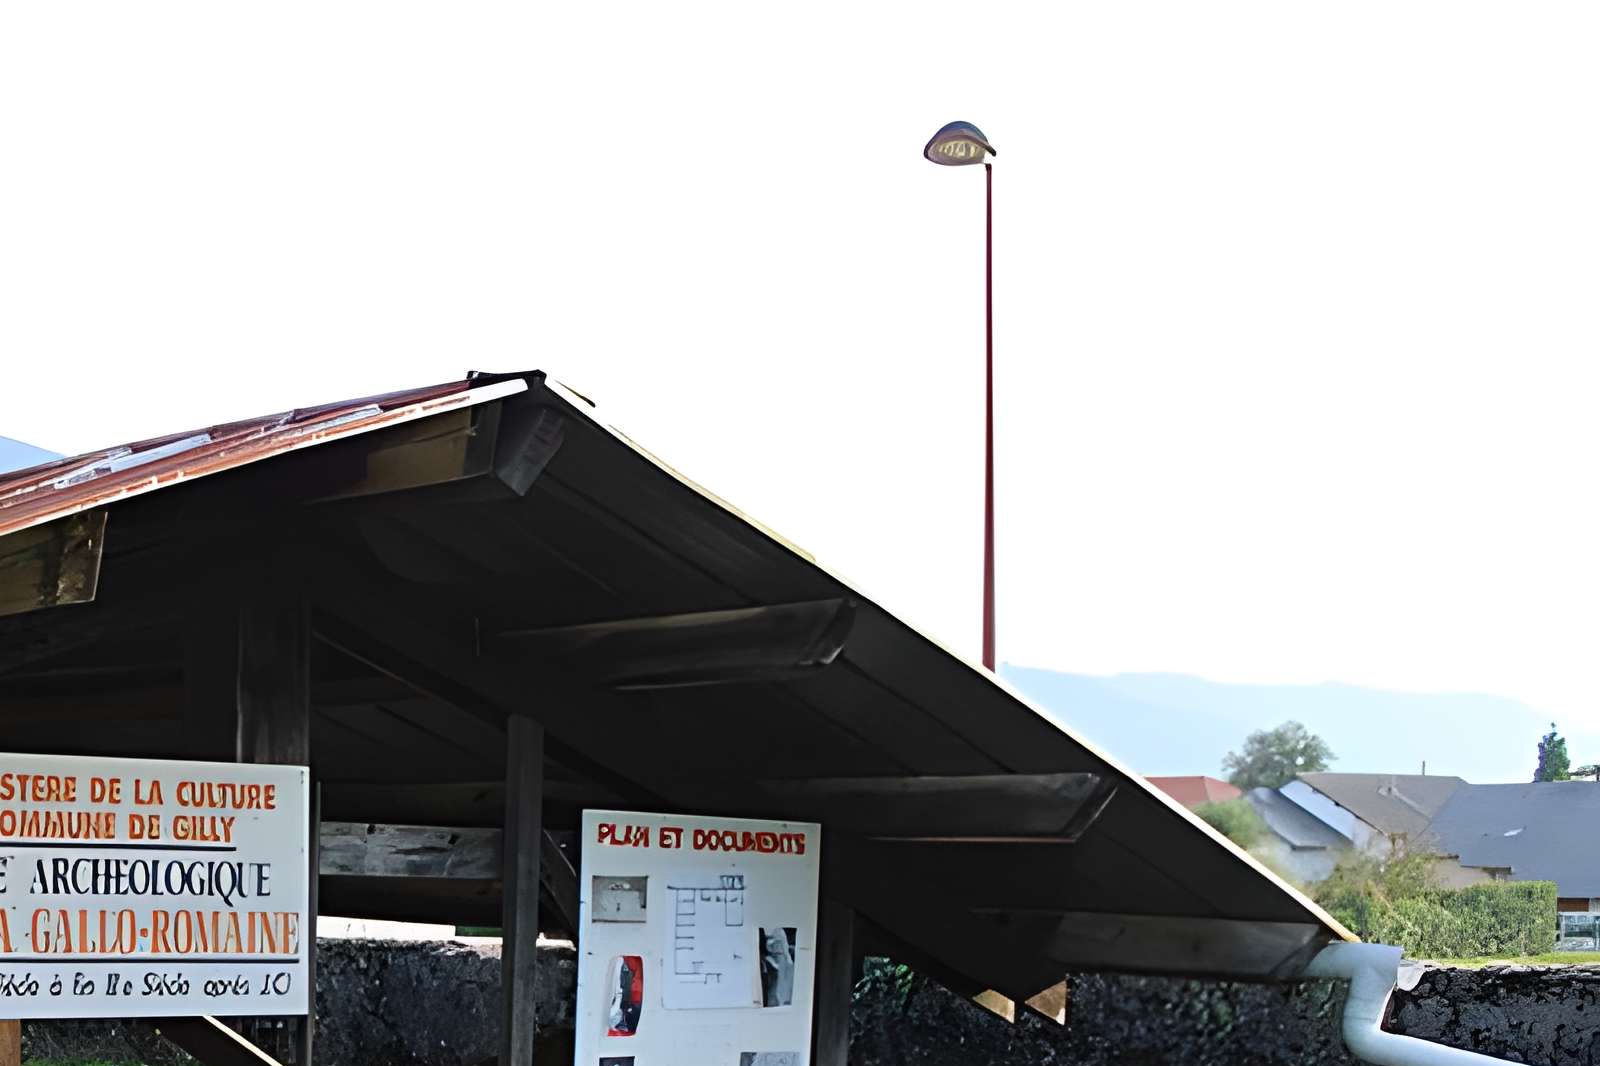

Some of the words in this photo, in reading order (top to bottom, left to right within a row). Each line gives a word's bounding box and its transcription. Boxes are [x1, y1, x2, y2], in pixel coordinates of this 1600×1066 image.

[90, 777, 121, 804] DE
[134, 778, 164, 805] LA
[175, 781, 277, 810] CULTURE
[128, 813, 161, 840] DE
[172, 814, 236, 843] GILLY
[597, 822, 650, 848] PLAN
[659, 826, 684, 849] ET
[29, 857, 272, 908] ARCHEOLOGIQUE
